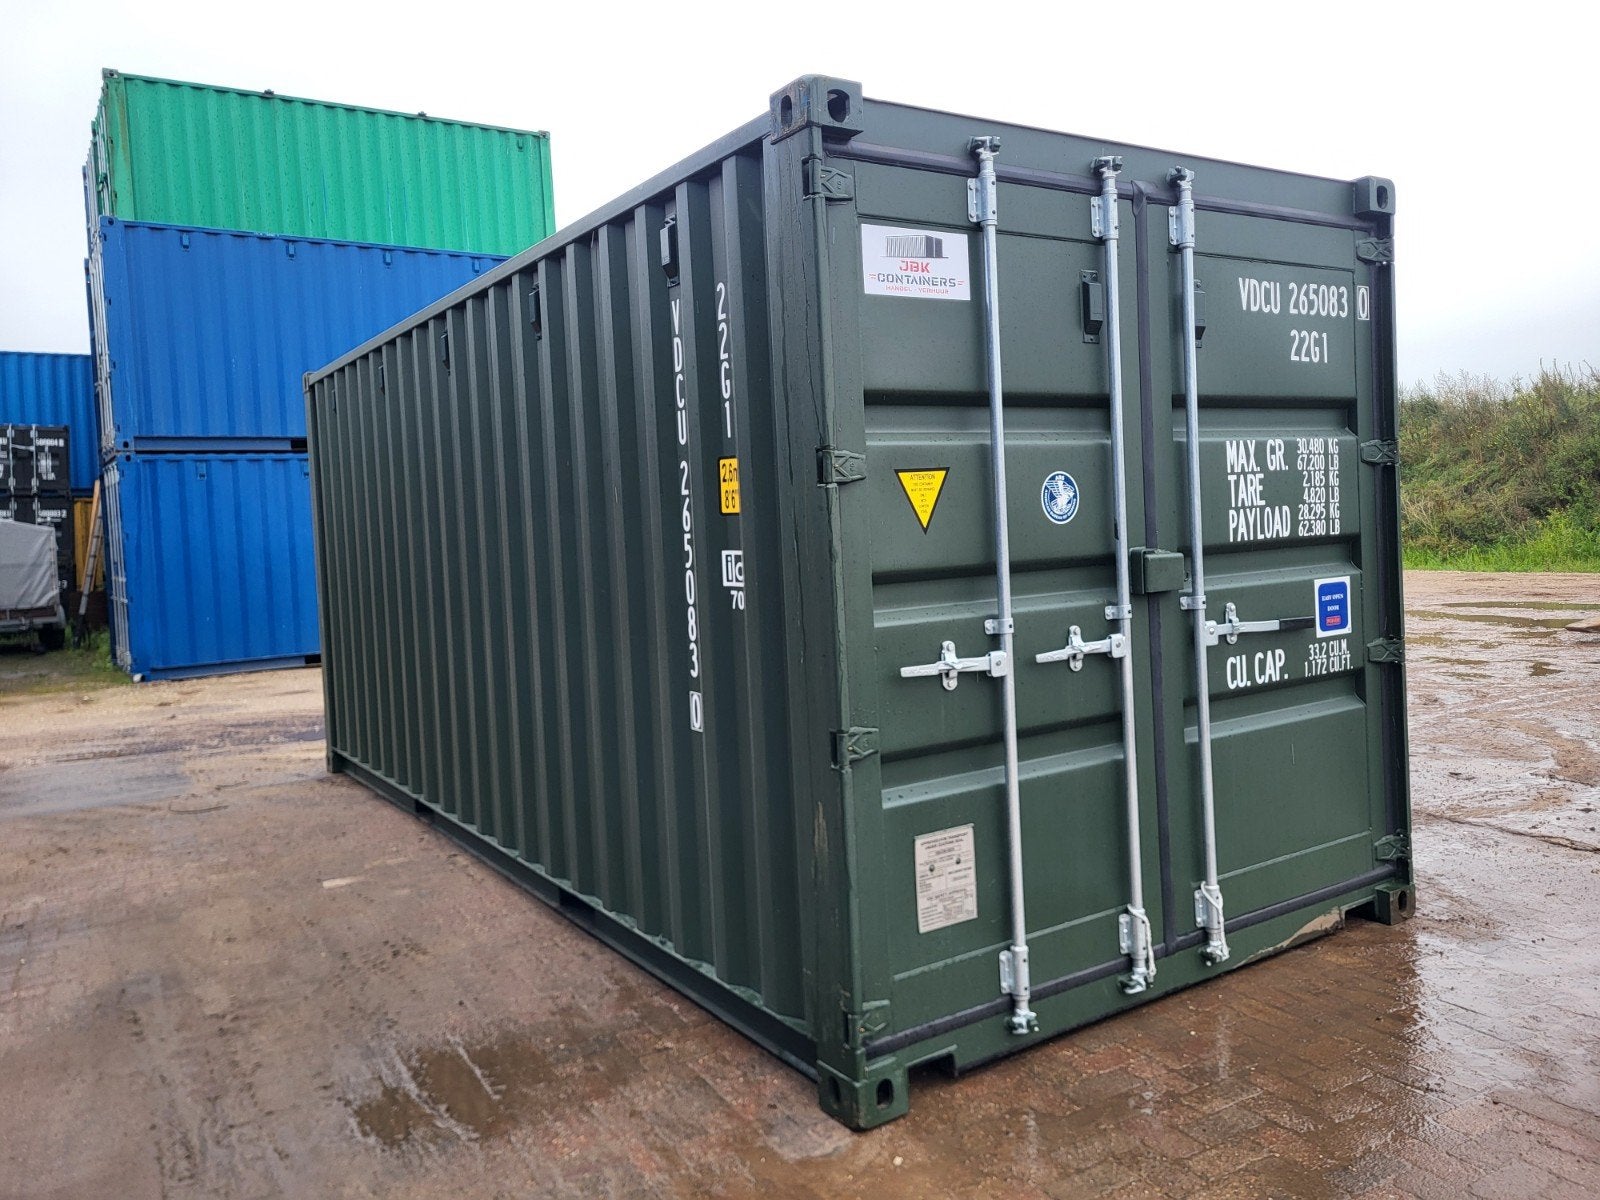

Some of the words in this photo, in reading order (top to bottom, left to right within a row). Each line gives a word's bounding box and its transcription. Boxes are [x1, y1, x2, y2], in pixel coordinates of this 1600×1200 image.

[877, 273, 956, 287] CONTAINERS
[900, 260, 930, 273] JBK
[1238, 277, 1280, 314] VDCU
[1288, 282, 1348, 318] 265083
[716, 282, 731, 438] 22G1
[1290, 329, 1328, 363] 22G1
[1226, 439, 1260, 473] MAX.
[1266, 438, 1289, 471] GR.
[1328, 438, 1339, 454] KG
[1329, 454, 1339, 470] LB
[1228, 473, 1266, 508] TARE
[1329, 471, 1339, 487] KG
[1329, 487, 1340, 503] LB
[1229, 505, 1291, 542] PAYLOAD
[1329, 503, 1340, 519] KG
[1329, 519, 1340, 535] LB
[1226, 654, 1251, 690] CU.
[1254, 648, 1289, 684] CAP.
[1308, 642, 1327, 661] 33.2
